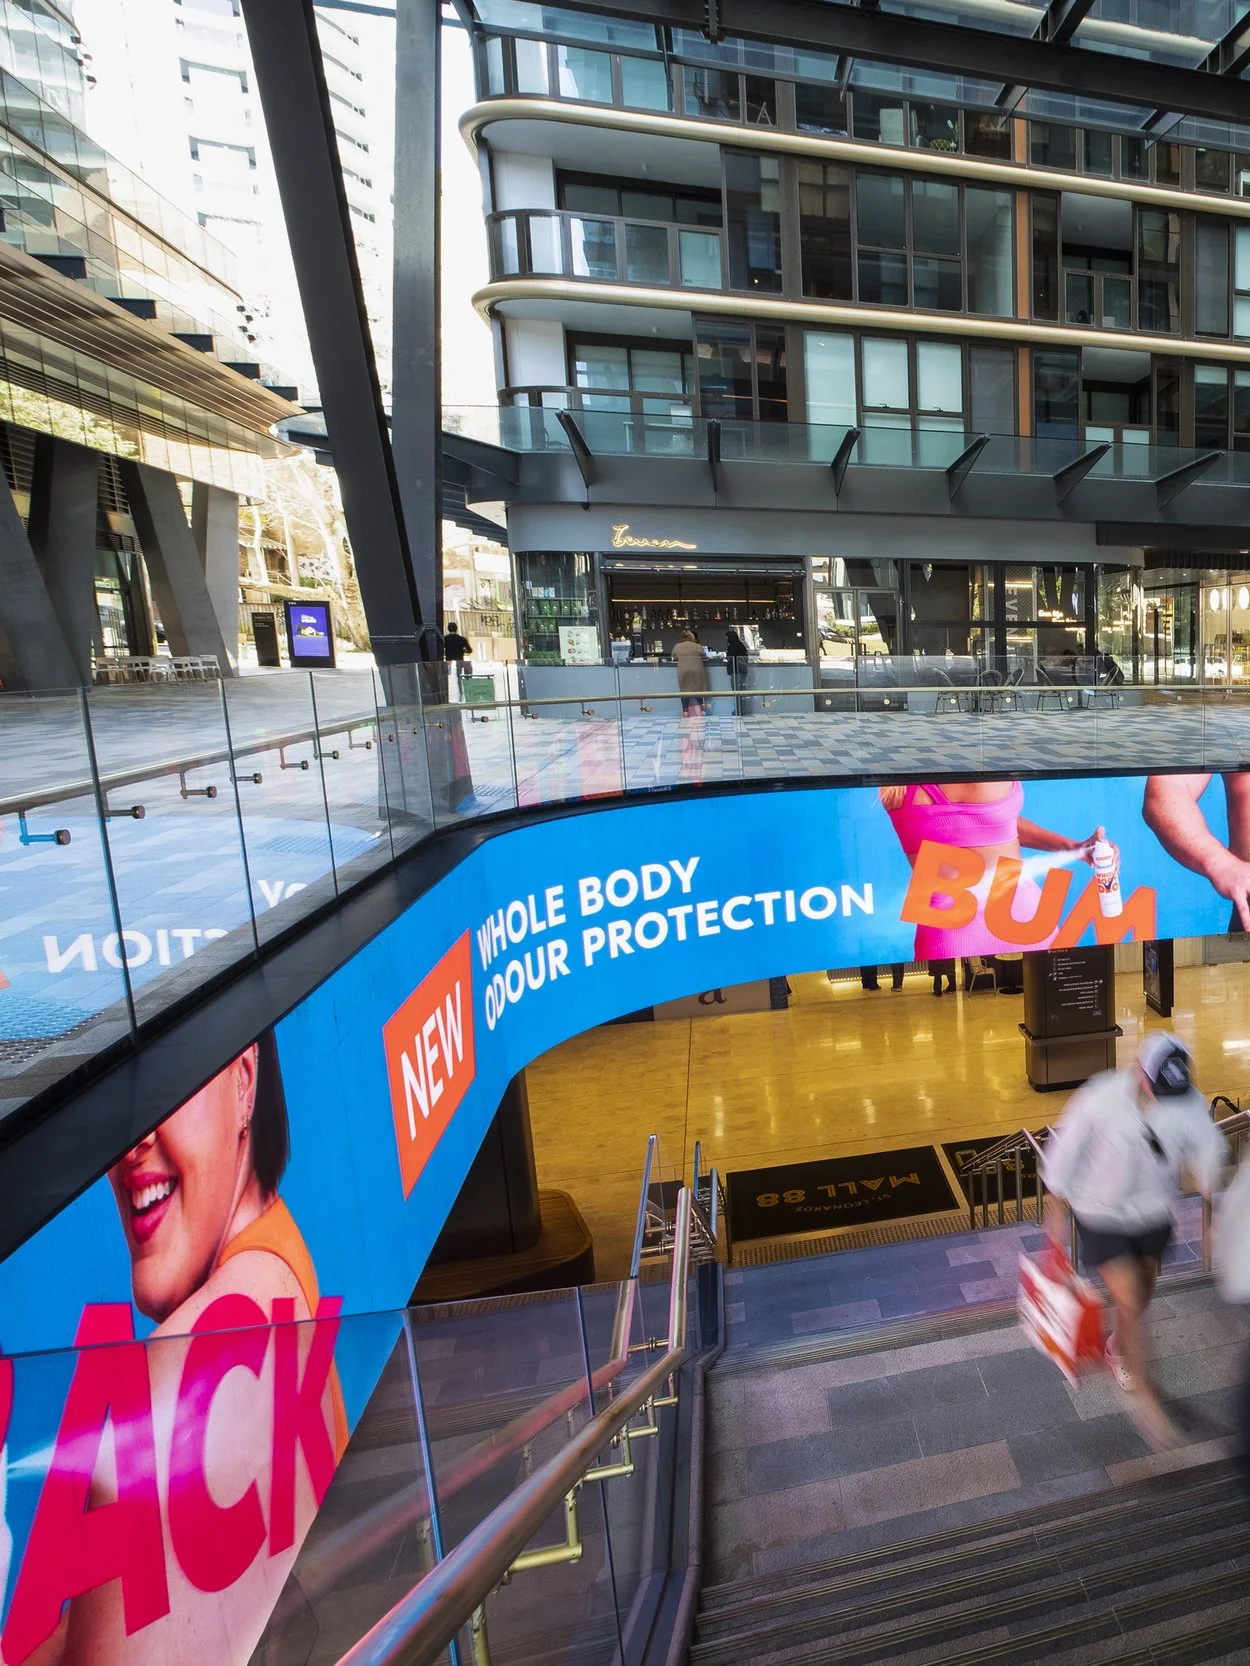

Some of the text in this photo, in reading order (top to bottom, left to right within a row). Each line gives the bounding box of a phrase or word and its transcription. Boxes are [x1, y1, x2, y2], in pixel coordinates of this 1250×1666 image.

[477, 857, 700, 972] WHOLE BODY
[484, 883, 875, 1032] ODOUR PROTECTION
[900, 840, 1156, 951] BUM
[400, 980, 464, 1142] NEW
[755, 1172, 922, 1208] MALL 88
[0, 1296, 344, 1666] ACK
